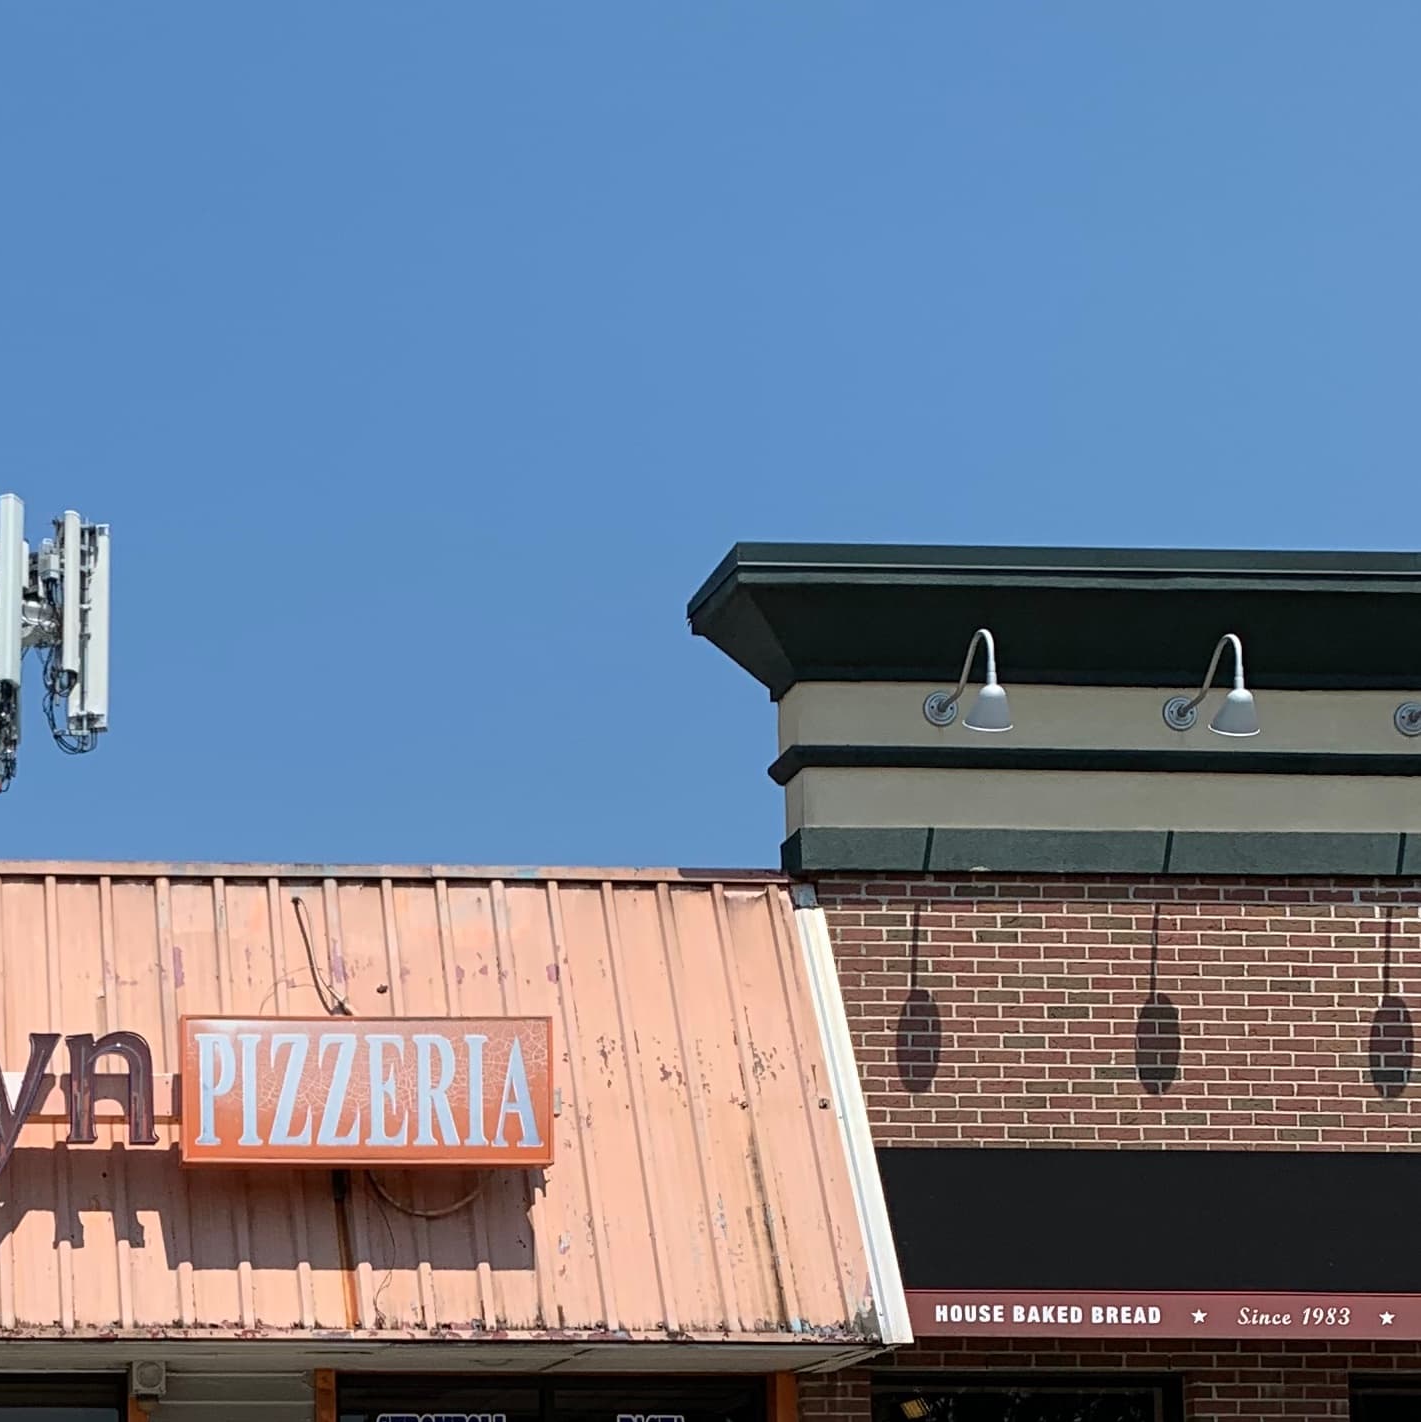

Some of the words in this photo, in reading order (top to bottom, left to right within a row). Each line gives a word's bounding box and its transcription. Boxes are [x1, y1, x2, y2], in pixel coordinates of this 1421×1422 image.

[194, 1032, 542, 1148] PIZZERIA
[935, 1305, 1005, 1323] HOUSE
[1012, 1306, 1083, 1324] BAKED
[1091, 1307, 1161, 1325] BREAD
[1237, 1307, 1292, 1326] Since
[1301, 1307, 1352, 1326] 1983
